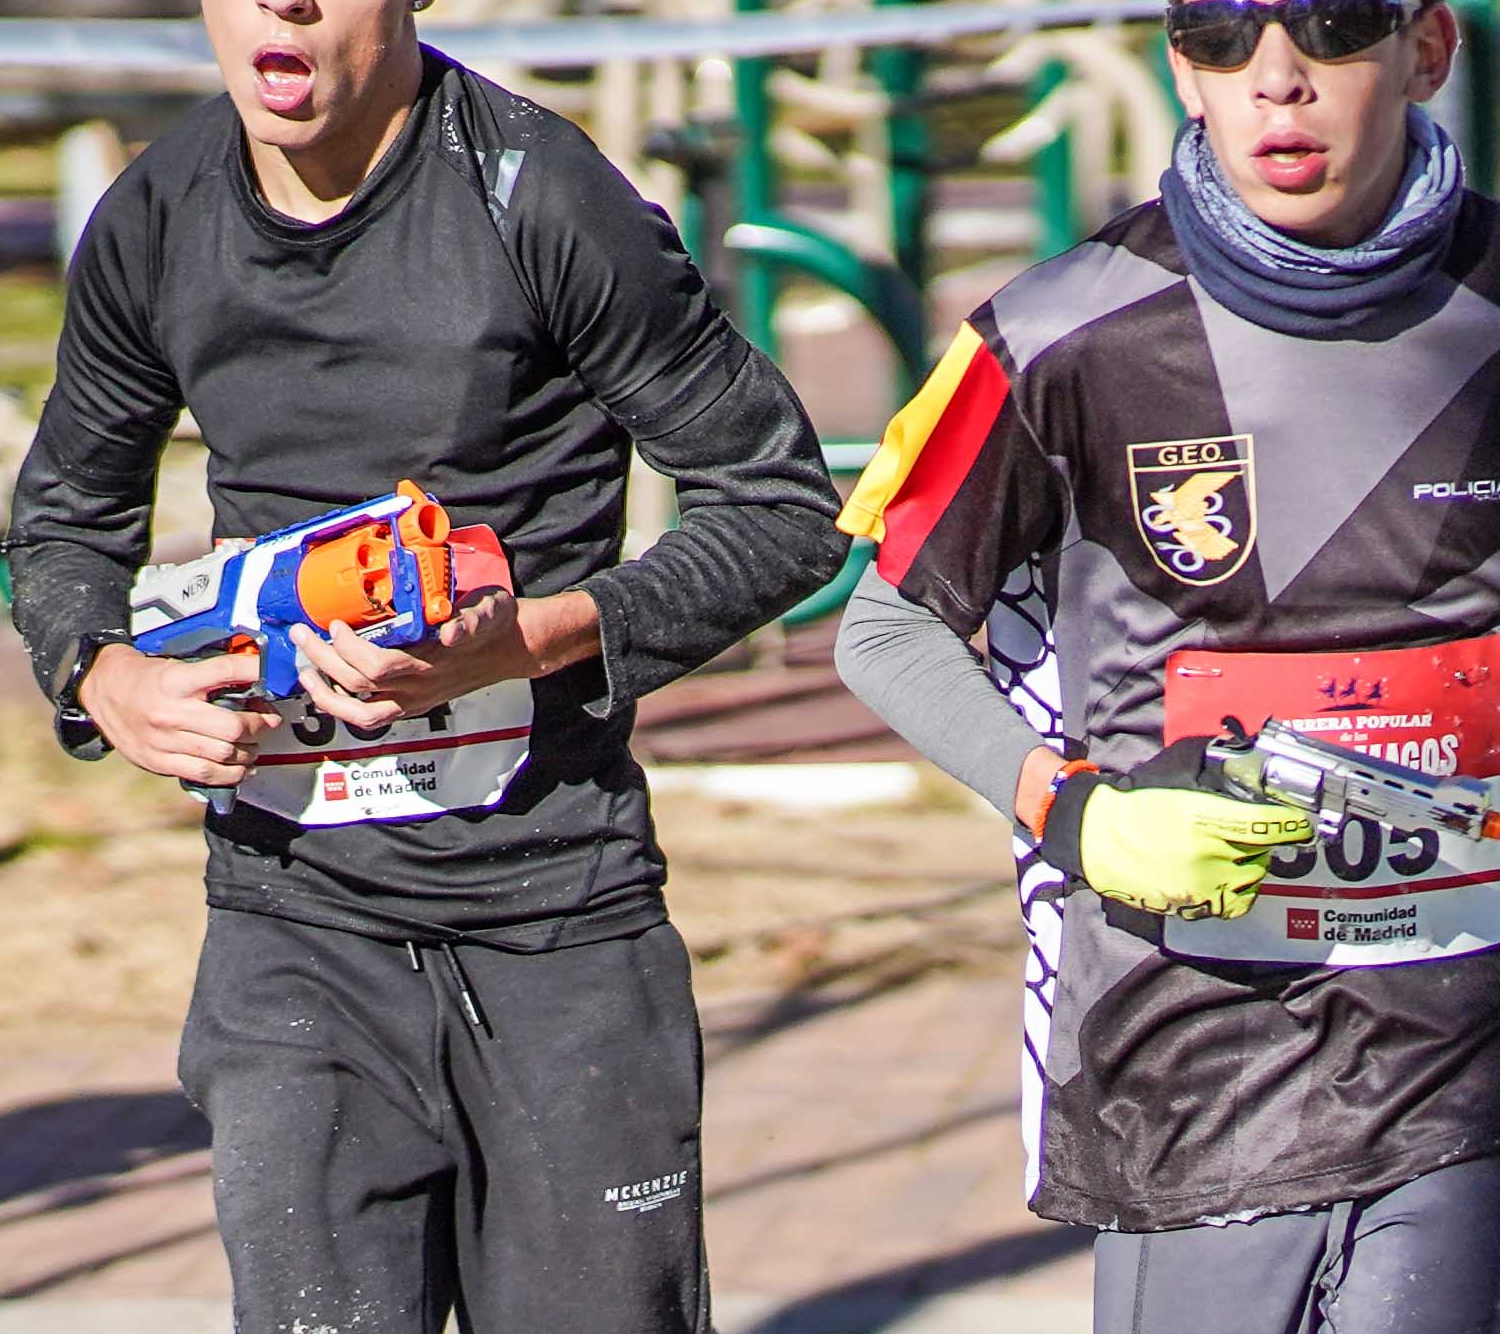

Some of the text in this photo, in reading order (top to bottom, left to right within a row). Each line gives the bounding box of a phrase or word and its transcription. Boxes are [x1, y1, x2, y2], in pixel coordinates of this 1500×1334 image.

[1158, 443, 1225, 466] G.E.O.
[1279, 712, 1433, 733] ARRERA POPULAR
[350, 760, 436, 781] Comunidad
[354, 777, 437, 798] de Madrid
[1323, 904, 1417, 924] Comunidad
[1323, 923, 1418, 943] de Madrid
[604, 1170, 688, 1202] MCKENZIE
